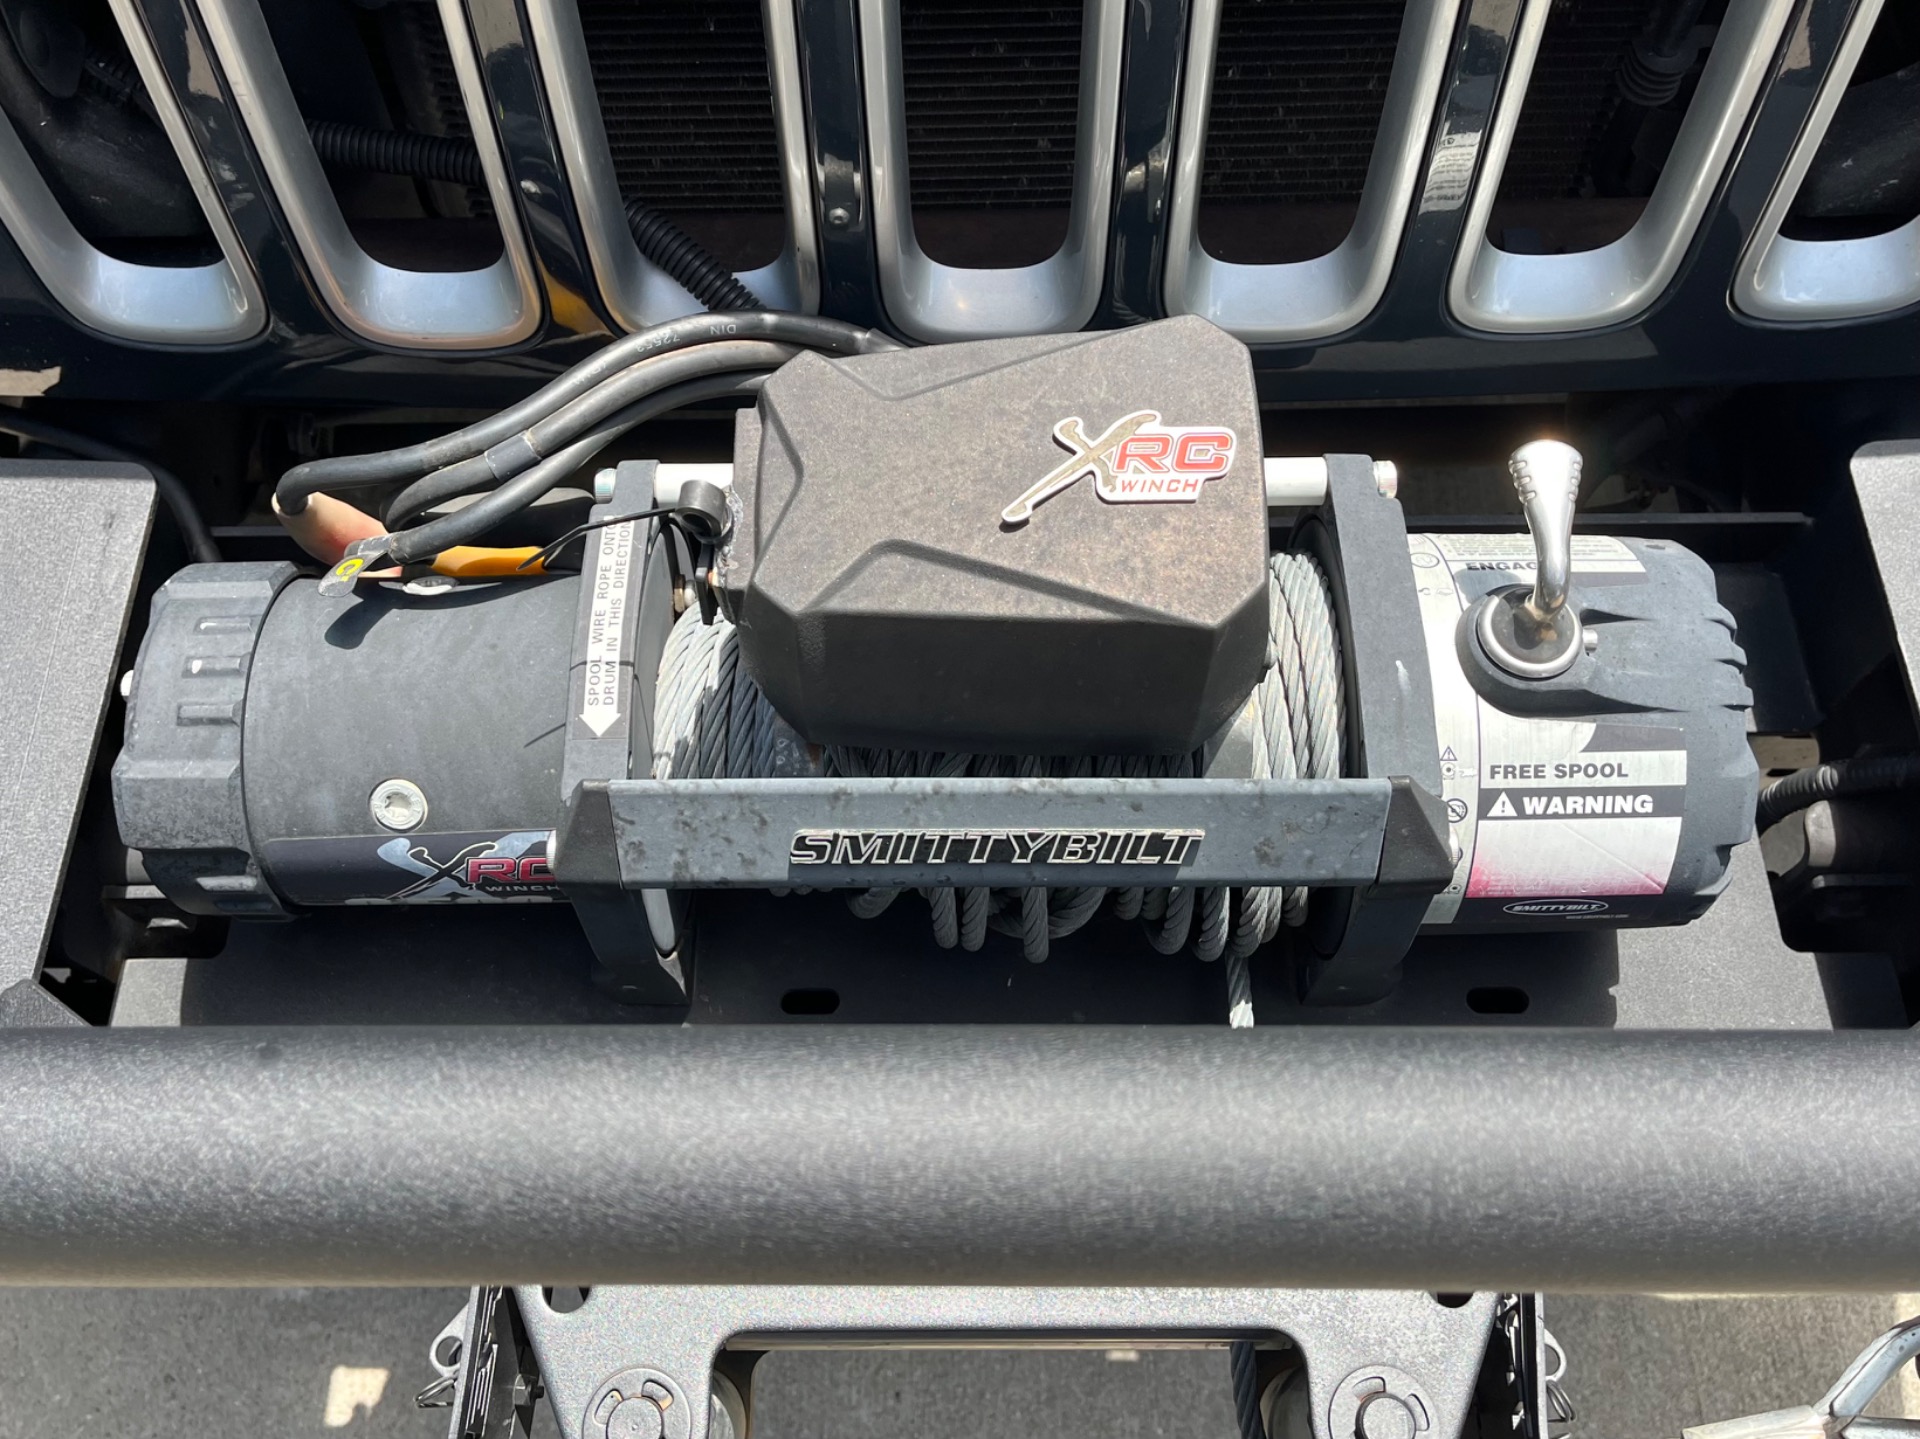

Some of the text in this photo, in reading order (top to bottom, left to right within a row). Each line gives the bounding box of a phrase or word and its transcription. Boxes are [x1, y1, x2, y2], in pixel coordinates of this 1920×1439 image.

[710, 324, 737, 335] DIN
[1003, 412, 1235, 521] XRC
[1121, 478, 1200, 494] WINCH
[596, 565, 612, 600] ROPE
[1466, 562, 1538, 571] ENGAG
[592, 609, 606, 644] WIRE
[603, 520, 631, 706] DRUM IN THIS DIRECTION
[588, 655, 602, 706] SPOOL
[1490, 763, 1629, 780] FREE SPOOL
[1523, 795, 1654, 815] WARNING
[789, 829, 1205, 864] SMITTYBILT
